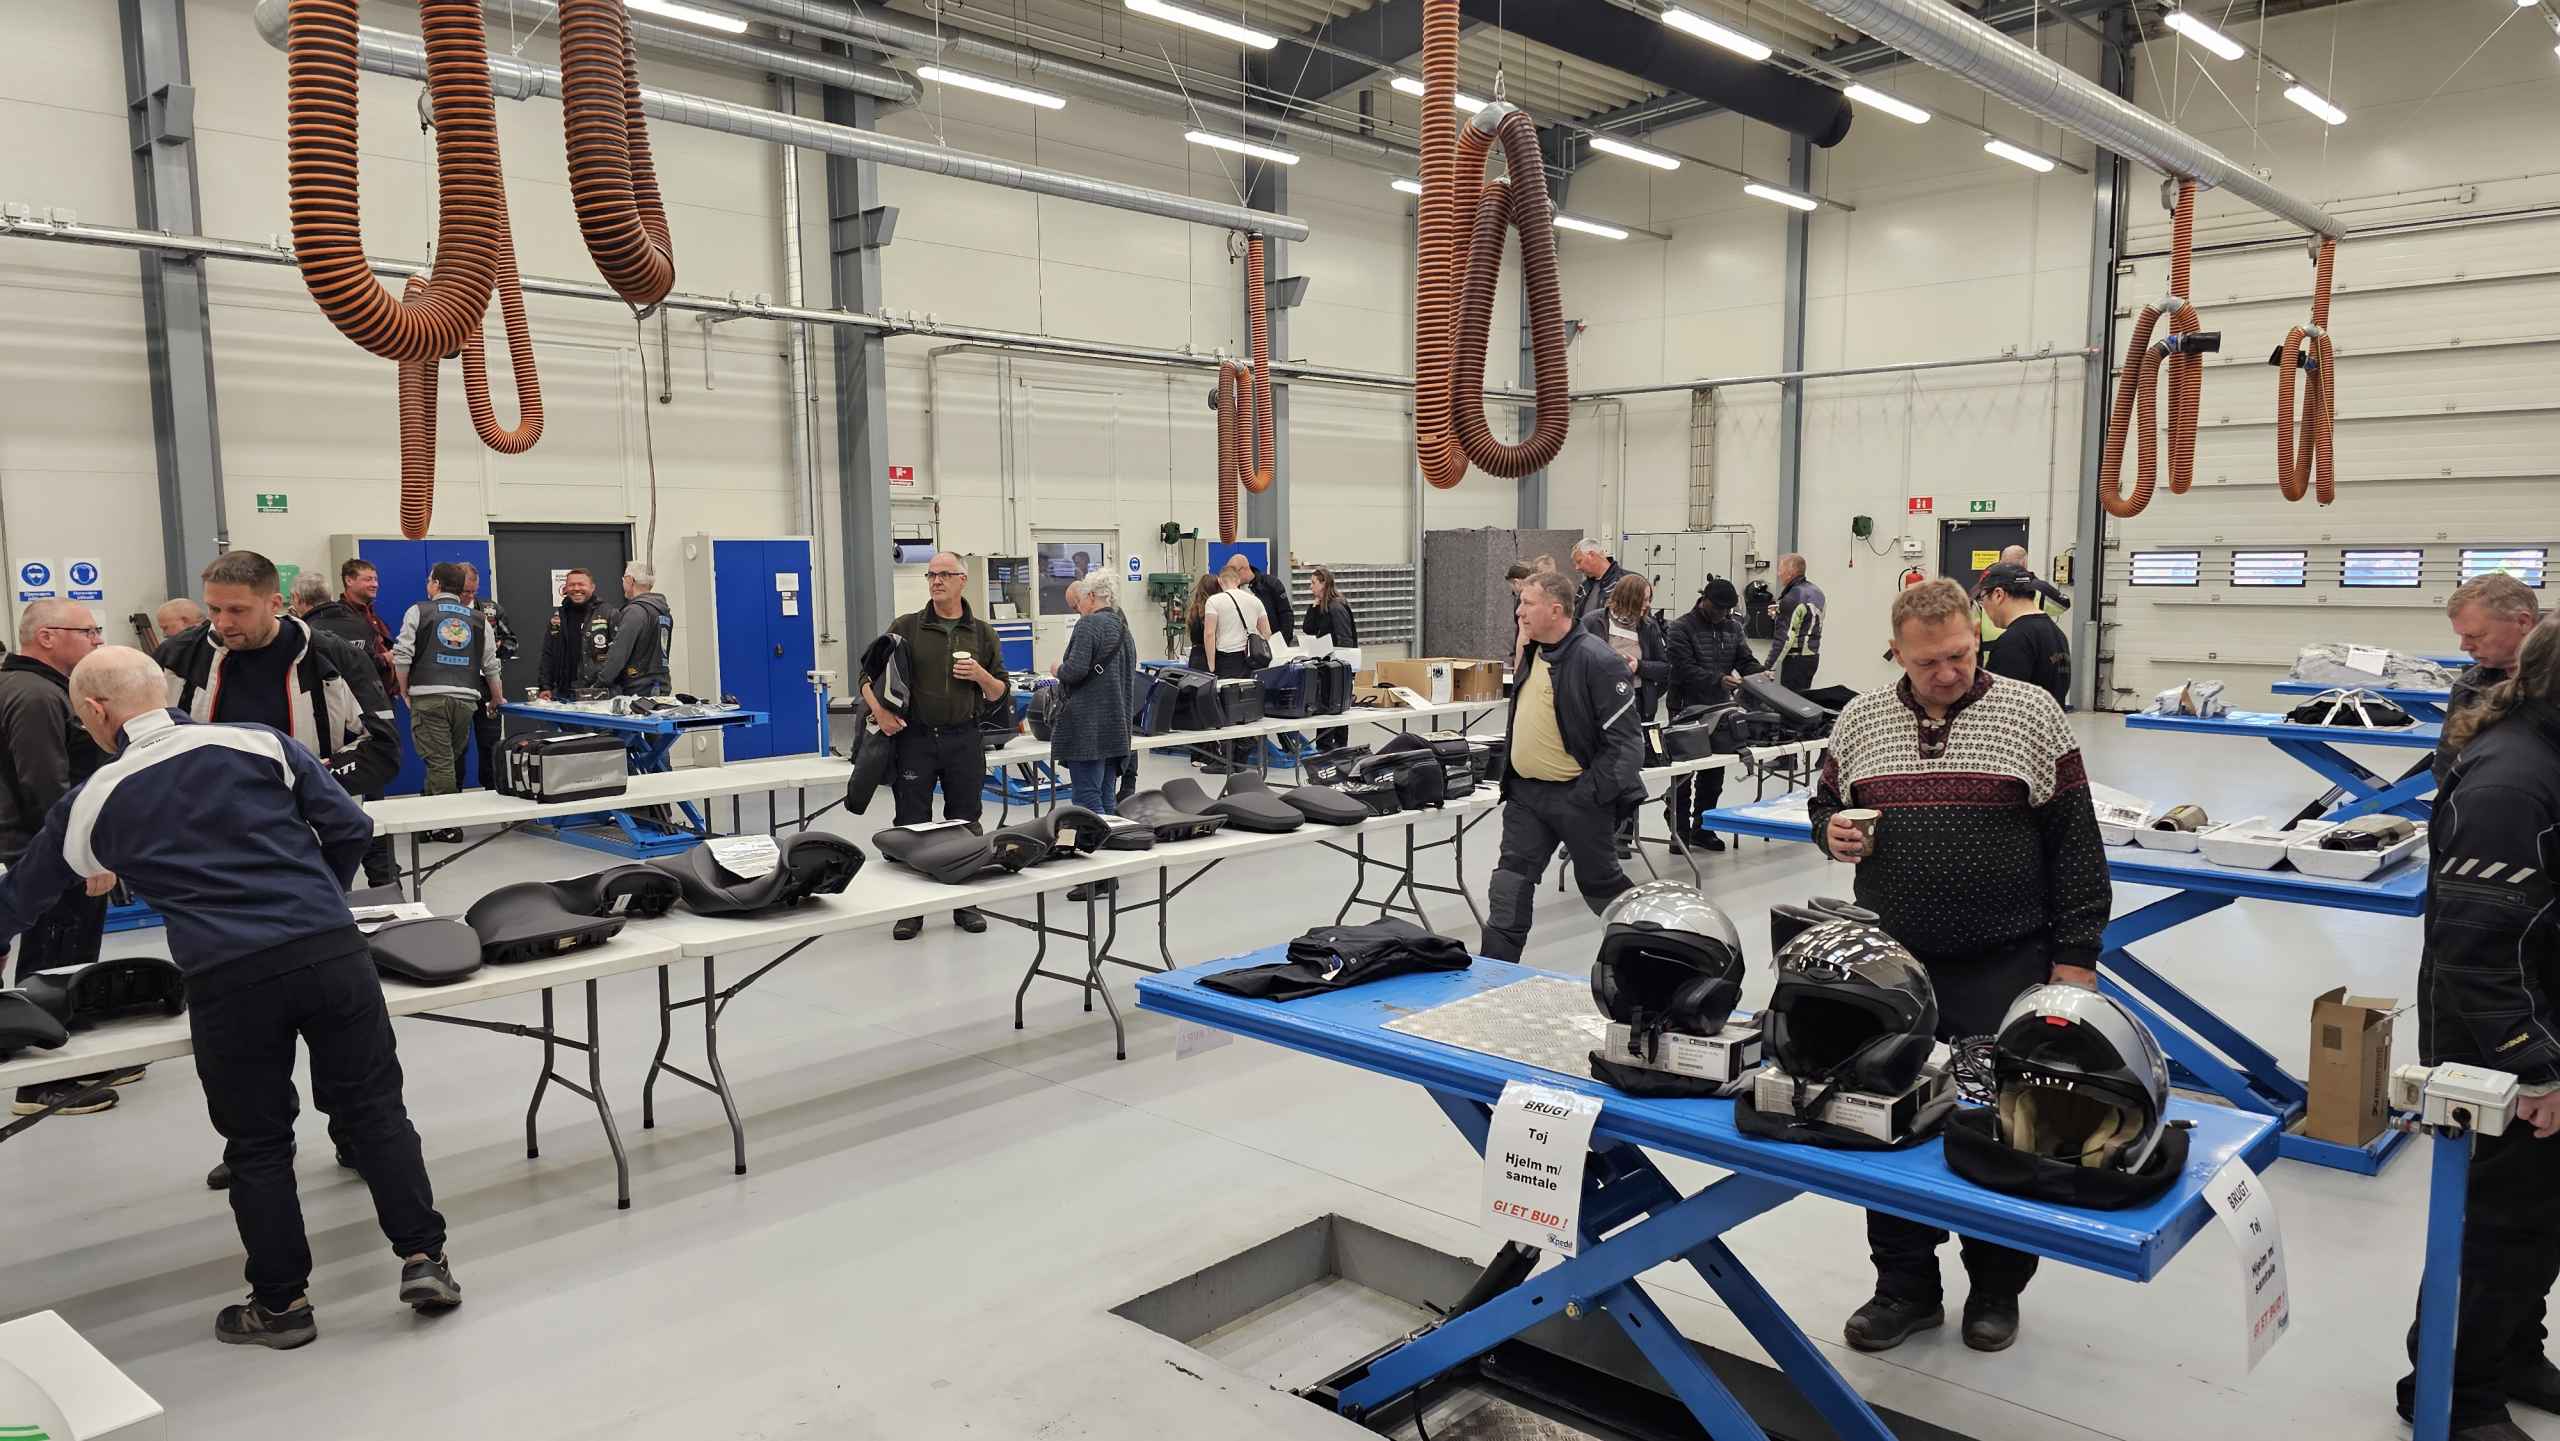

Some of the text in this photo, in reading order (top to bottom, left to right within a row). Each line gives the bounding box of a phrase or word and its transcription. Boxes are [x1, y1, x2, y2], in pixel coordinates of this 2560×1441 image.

[1318, 766, 1336, 779] GS
[1524, 1100, 1572, 1118] BRUGT
[1528, 1128, 1549, 1144] Tøj
[1505, 1152, 1562, 1176] Hjelm m/
[1506, 1170, 1557, 1191] samtale
[2227, 1180, 2249, 1210] BRUGT
[1530, 1209, 1560, 1227] BUD
